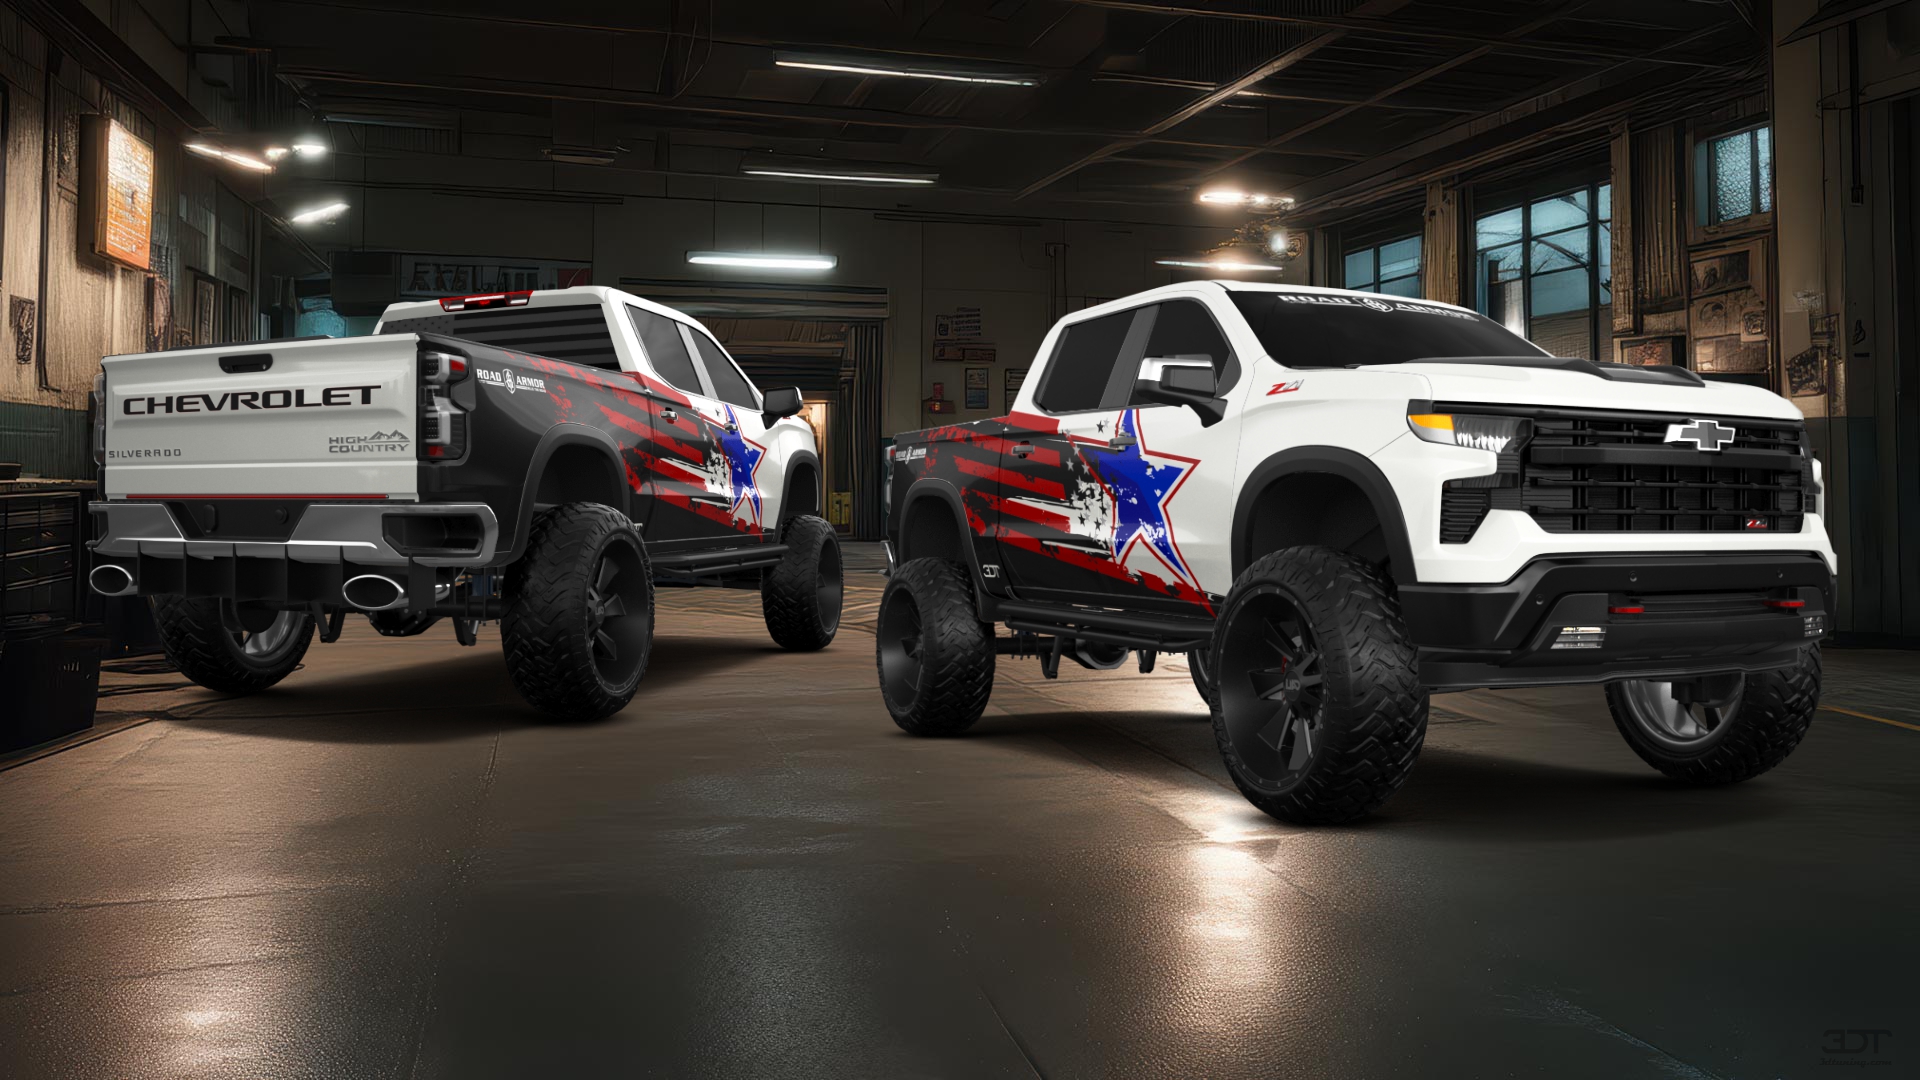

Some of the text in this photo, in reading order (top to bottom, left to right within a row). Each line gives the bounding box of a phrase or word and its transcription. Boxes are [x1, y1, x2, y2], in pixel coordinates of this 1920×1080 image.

[476, 368, 502, 382] ROAD
[516, 375, 545, 389] ARMOR
[123, 385, 382, 416] CHEVROLET
[329, 436, 367, 445] HIGH
[108, 448, 182, 459] SILVERADO
[329, 443, 409, 453] COUNTRY
[982, 564, 1000, 578] 3DT
